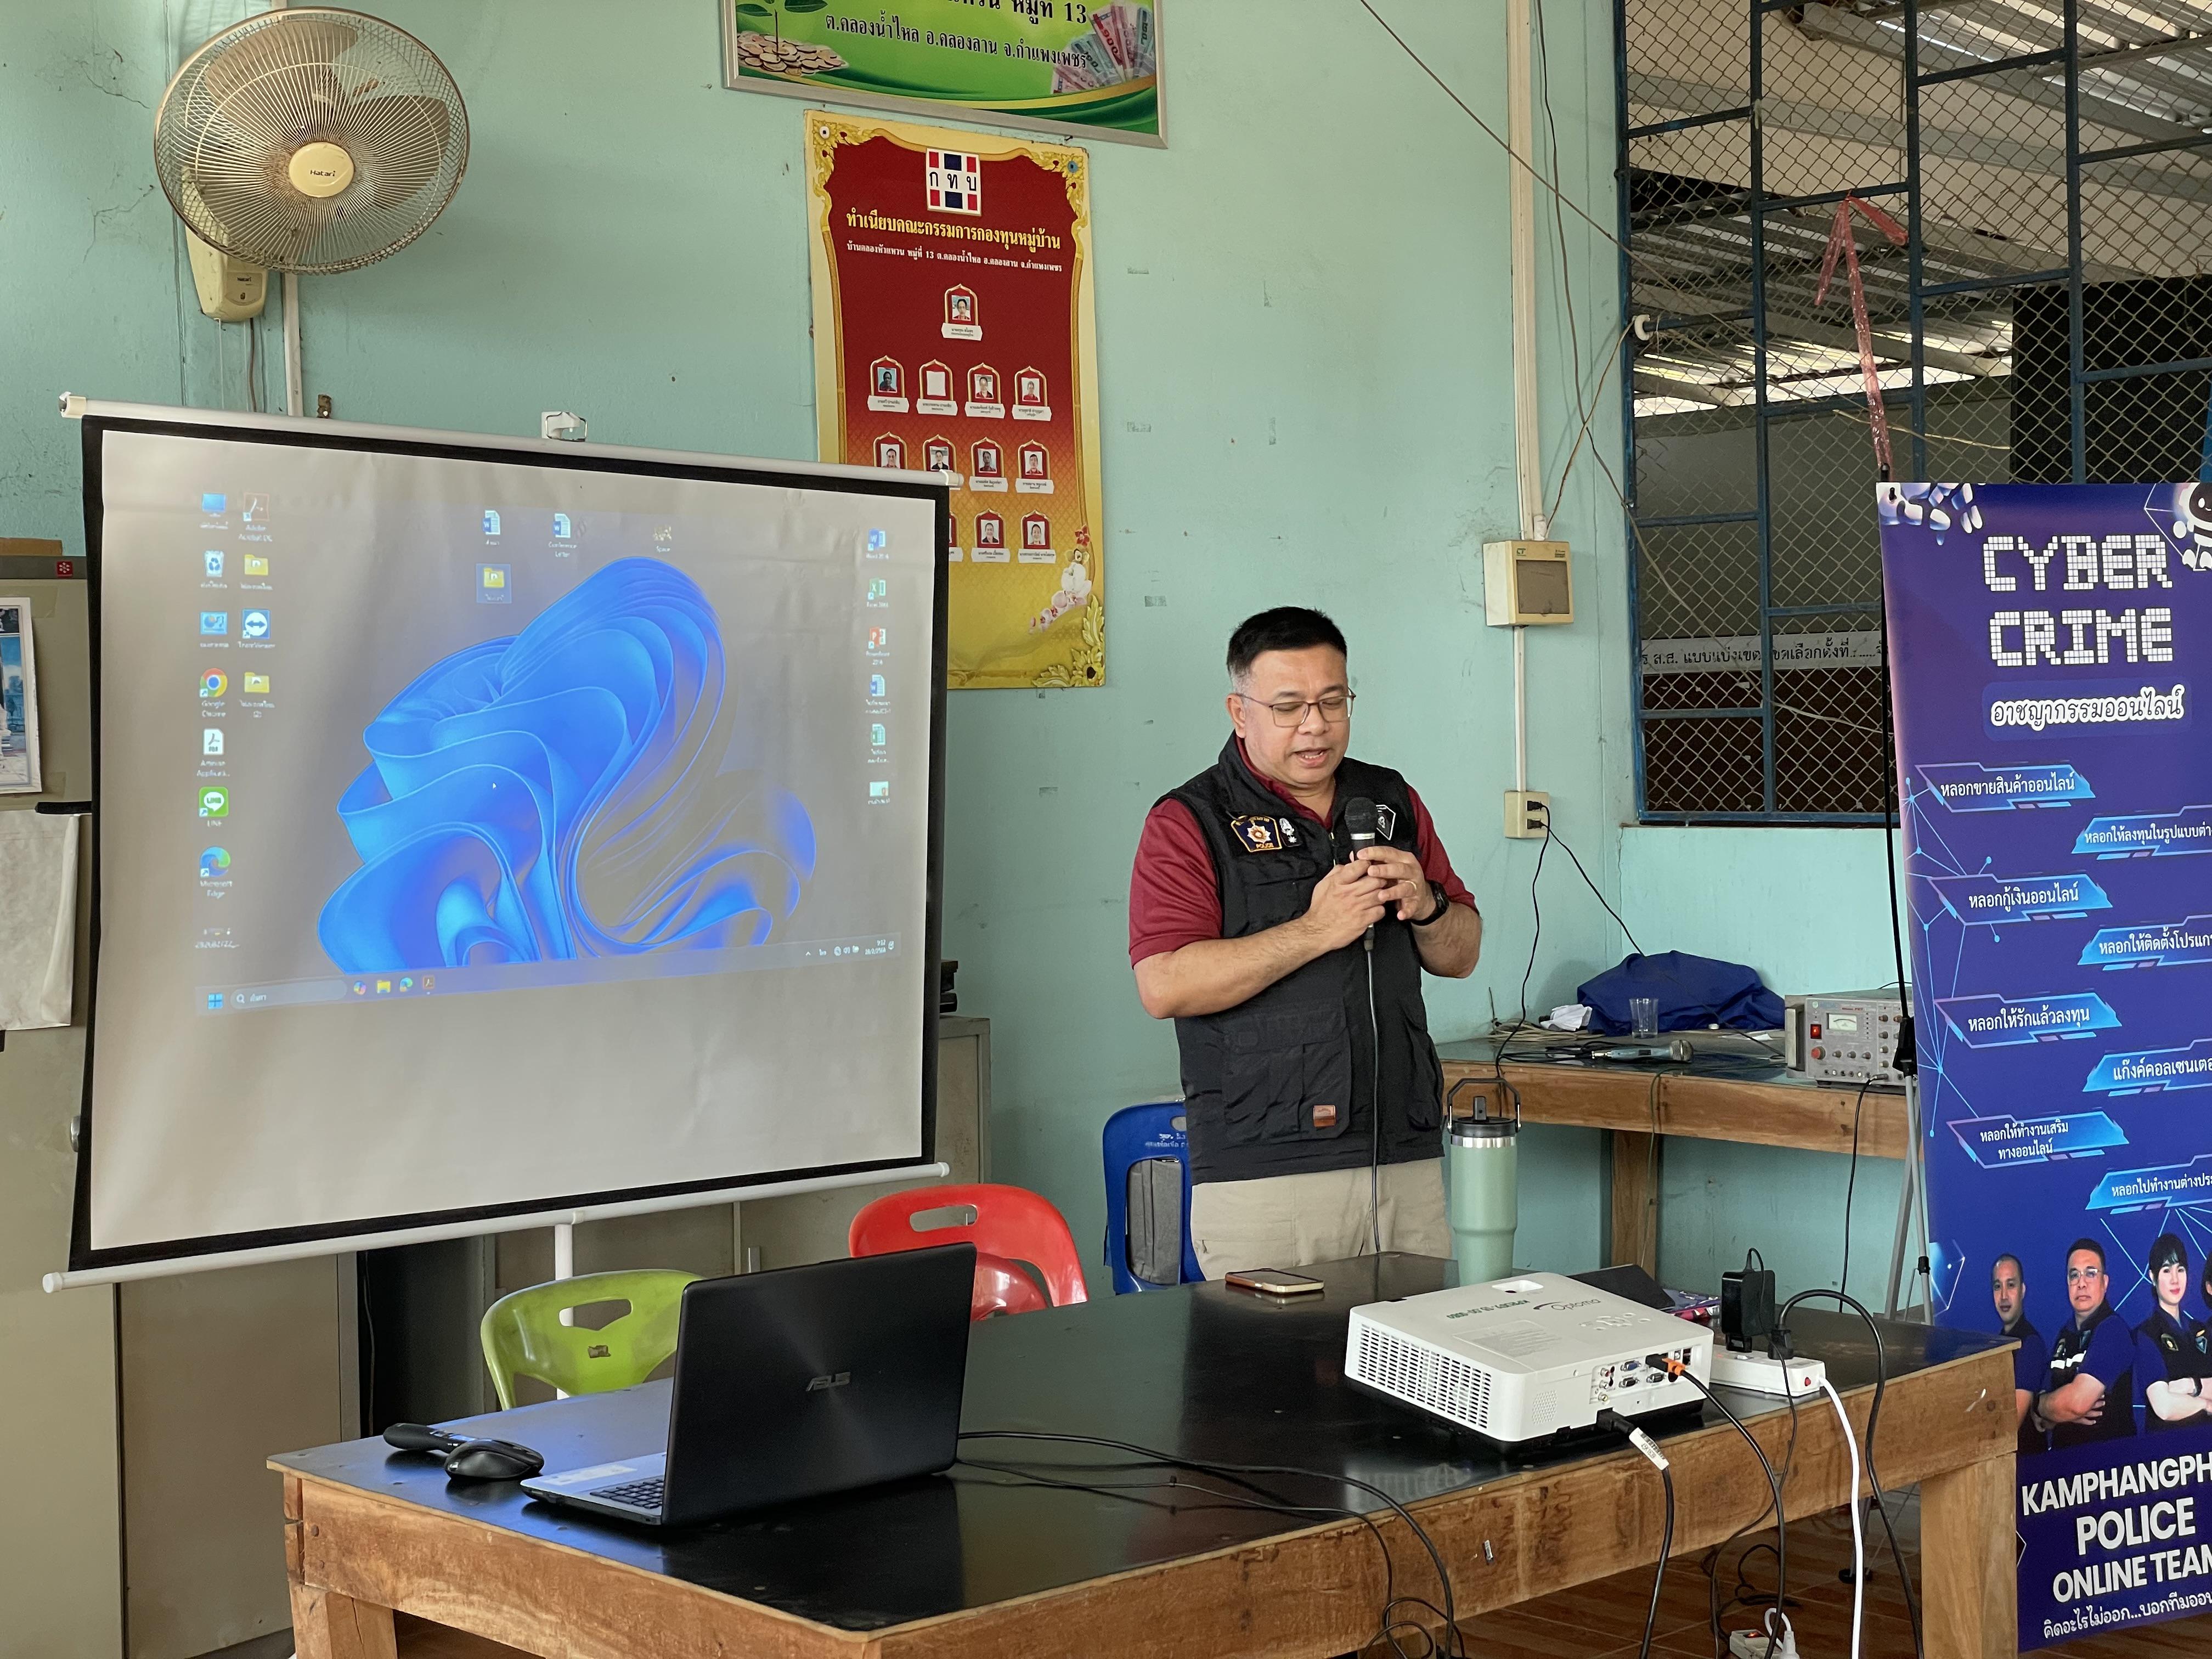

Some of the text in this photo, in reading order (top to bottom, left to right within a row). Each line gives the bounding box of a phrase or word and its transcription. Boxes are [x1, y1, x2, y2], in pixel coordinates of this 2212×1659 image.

[1064, 2, 1087, 24] 13
[825, 9, 919, 43] ต.คลองน้ำไหล
[926, 30, 998, 55] อ.คลองลาน
[310, 169, 336, 178] Hatari
[846, 206, 1060, 253] ทำเนียบคณะกรรมการกองทุนหมู่บ้าน
[907, 245, 923, 261] หมู่ที่
[926, 251, 935, 259] 13
[937, 250, 981, 264] ต.คลองน้ำไหล
[984, 258, 1018, 268] อ.คลองลาน
[1983, 534, 2174, 591] CYBER
[1989, 607, 2174, 667] CRIME
[1992, 685, 2185, 730] อาชญากรรมออนไลน์
[1940, 770, 2075, 798] หลอกขายสินค้าออนไลน์
[2084, 820, 2212, 847] หลอกให้ลงทุนในรูปแบบต่า
[1968, 881, 2079, 913] หลอกกู้เงินออนไลน์
[1967, 1004, 2091, 1034] หลอกให้รักแล้วลงทุน
[1979, 1119, 2069, 1143] หลอกให้ทำงานเสริม
[1997, 1137, 2054, 1160] ทางออนไลน์
[1550, 1298, 1602, 1311] Optoma
[805, 1372, 851, 1392] ASUS
[2076, 1497, 2196, 1556] POLICE
[2052, 1555, 2147, 1603] ONLINE
